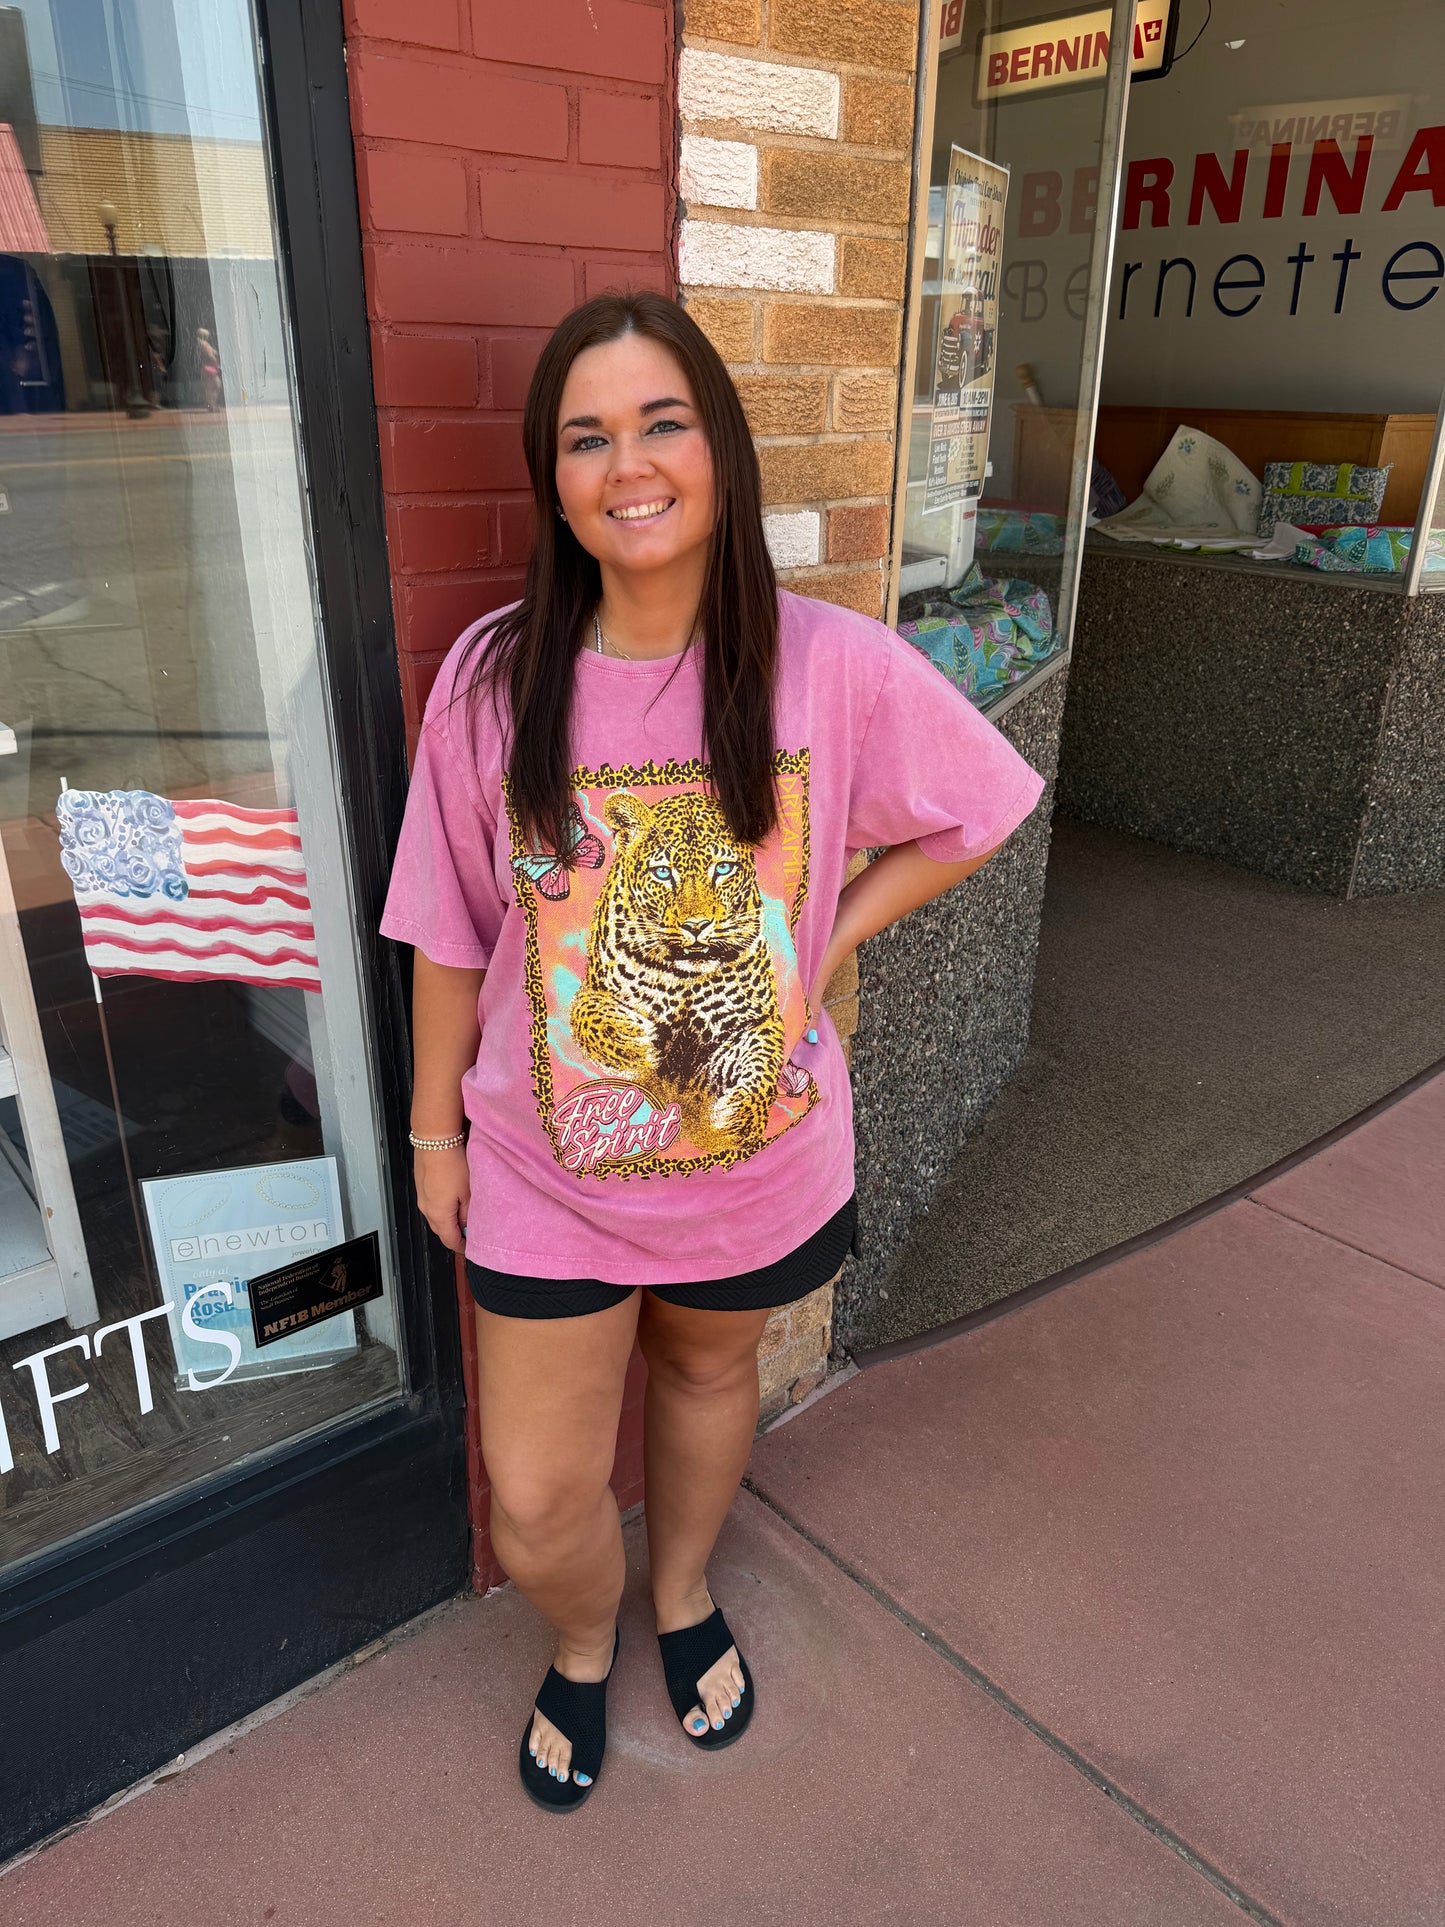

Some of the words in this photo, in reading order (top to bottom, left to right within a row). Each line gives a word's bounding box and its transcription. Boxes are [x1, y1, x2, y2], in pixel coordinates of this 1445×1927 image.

[776, 776, 800, 895] DREAMER
[551, 1086, 644, 1148] Free
[563, 1104, 680, 1170] Spirit
[263, 1309, 309, 1337] NFIB
[311, 1284, 373, 1318] Member
